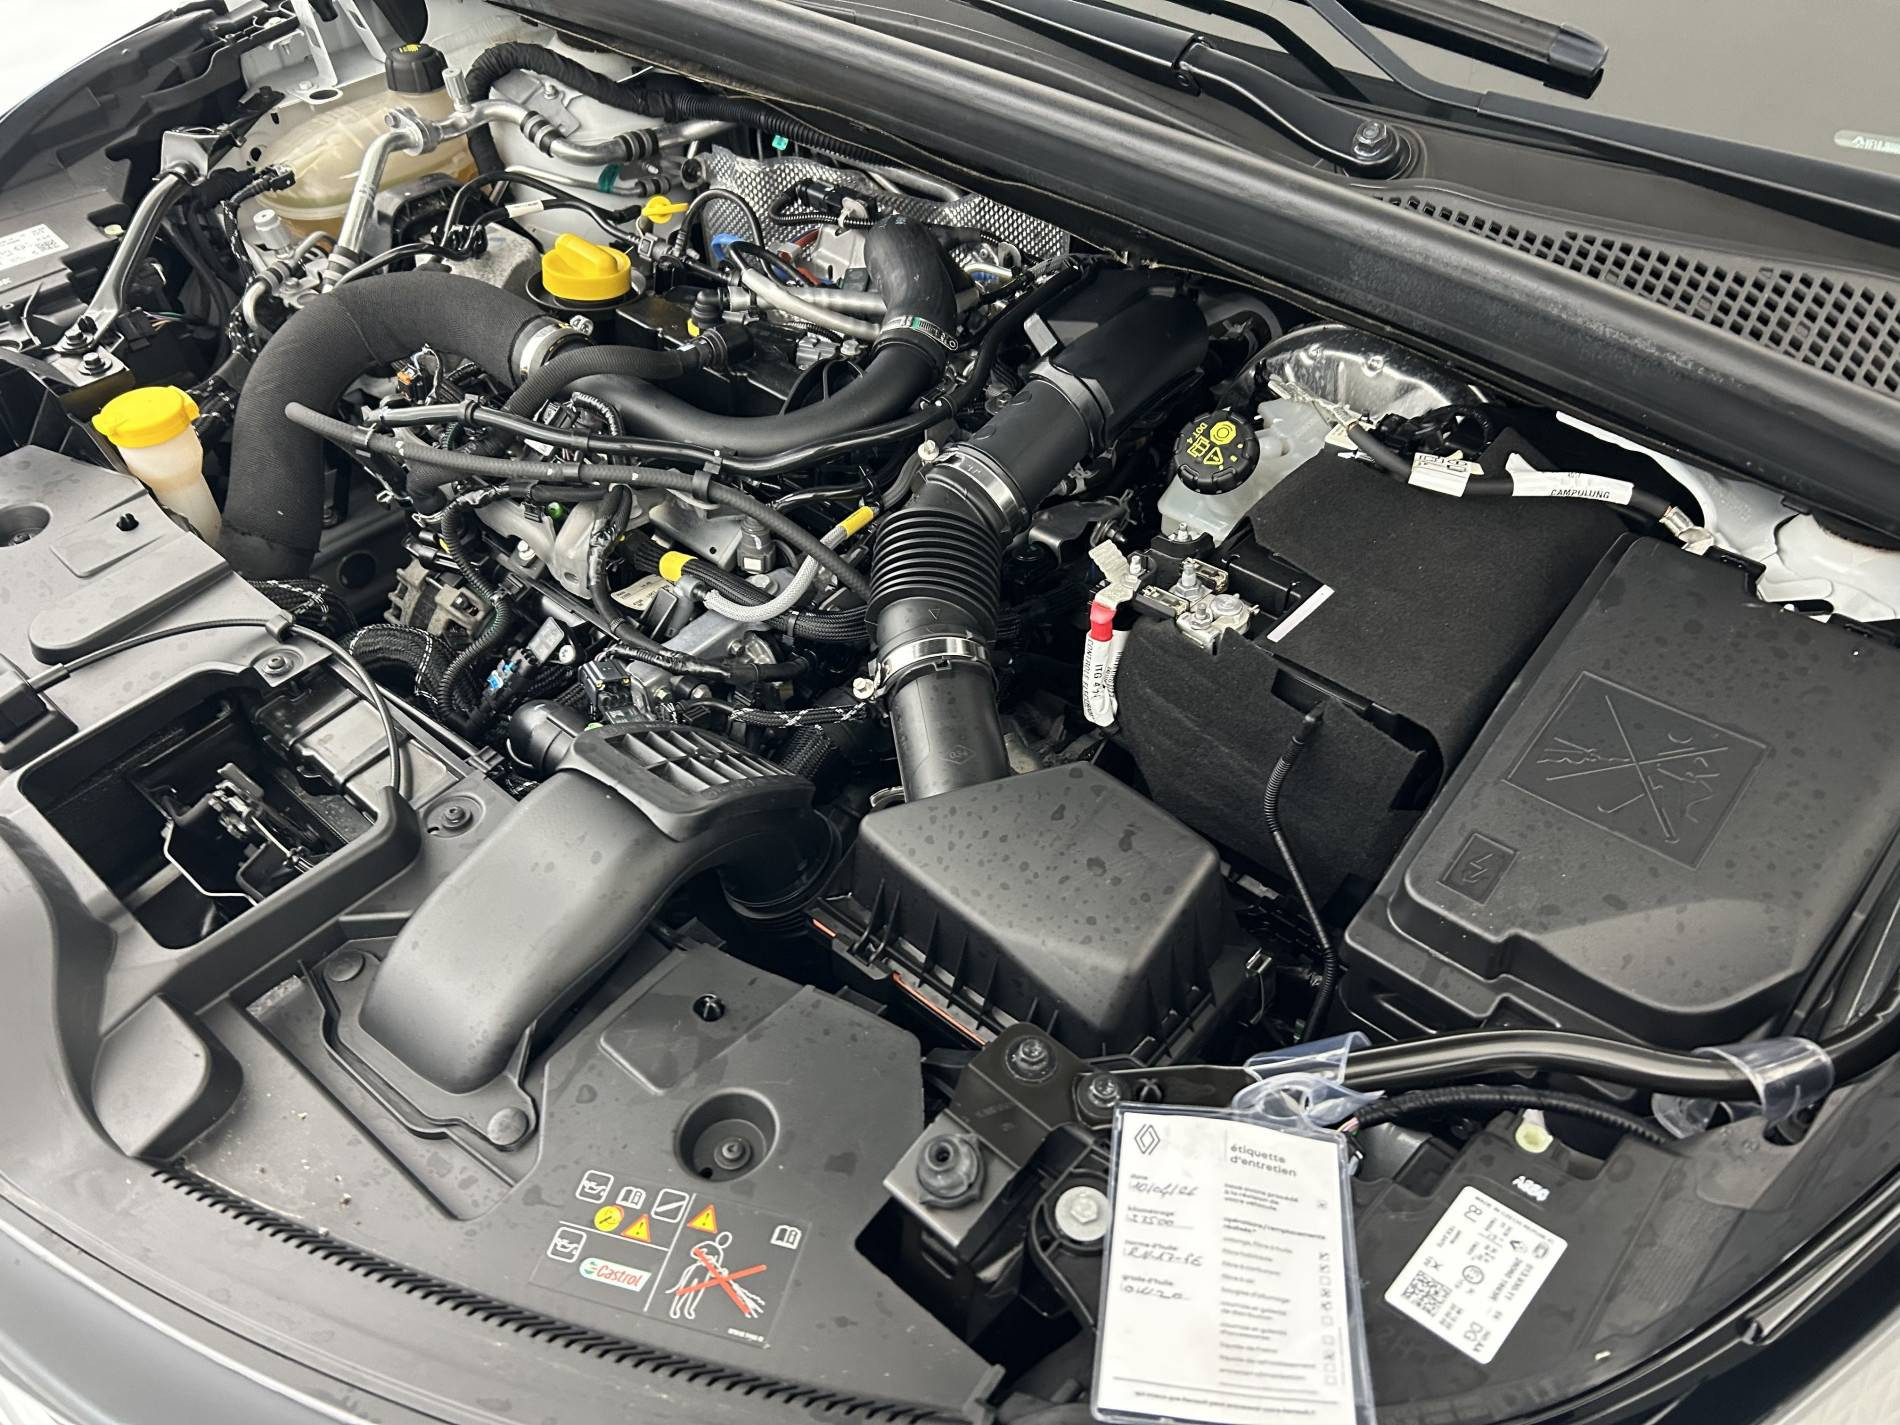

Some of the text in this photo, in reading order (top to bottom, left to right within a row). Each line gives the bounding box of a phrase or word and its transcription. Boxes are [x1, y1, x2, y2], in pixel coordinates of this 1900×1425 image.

[1192, 422, 1208, 438] DOT
[1550, 488, 1611, 499] CAMPULUNG
[1230, 1144, 1286, 1163] étiquette
[1230, 1156, 1297, 1177] d'entretien
[596, 1263, 644, 1287] Castrol
